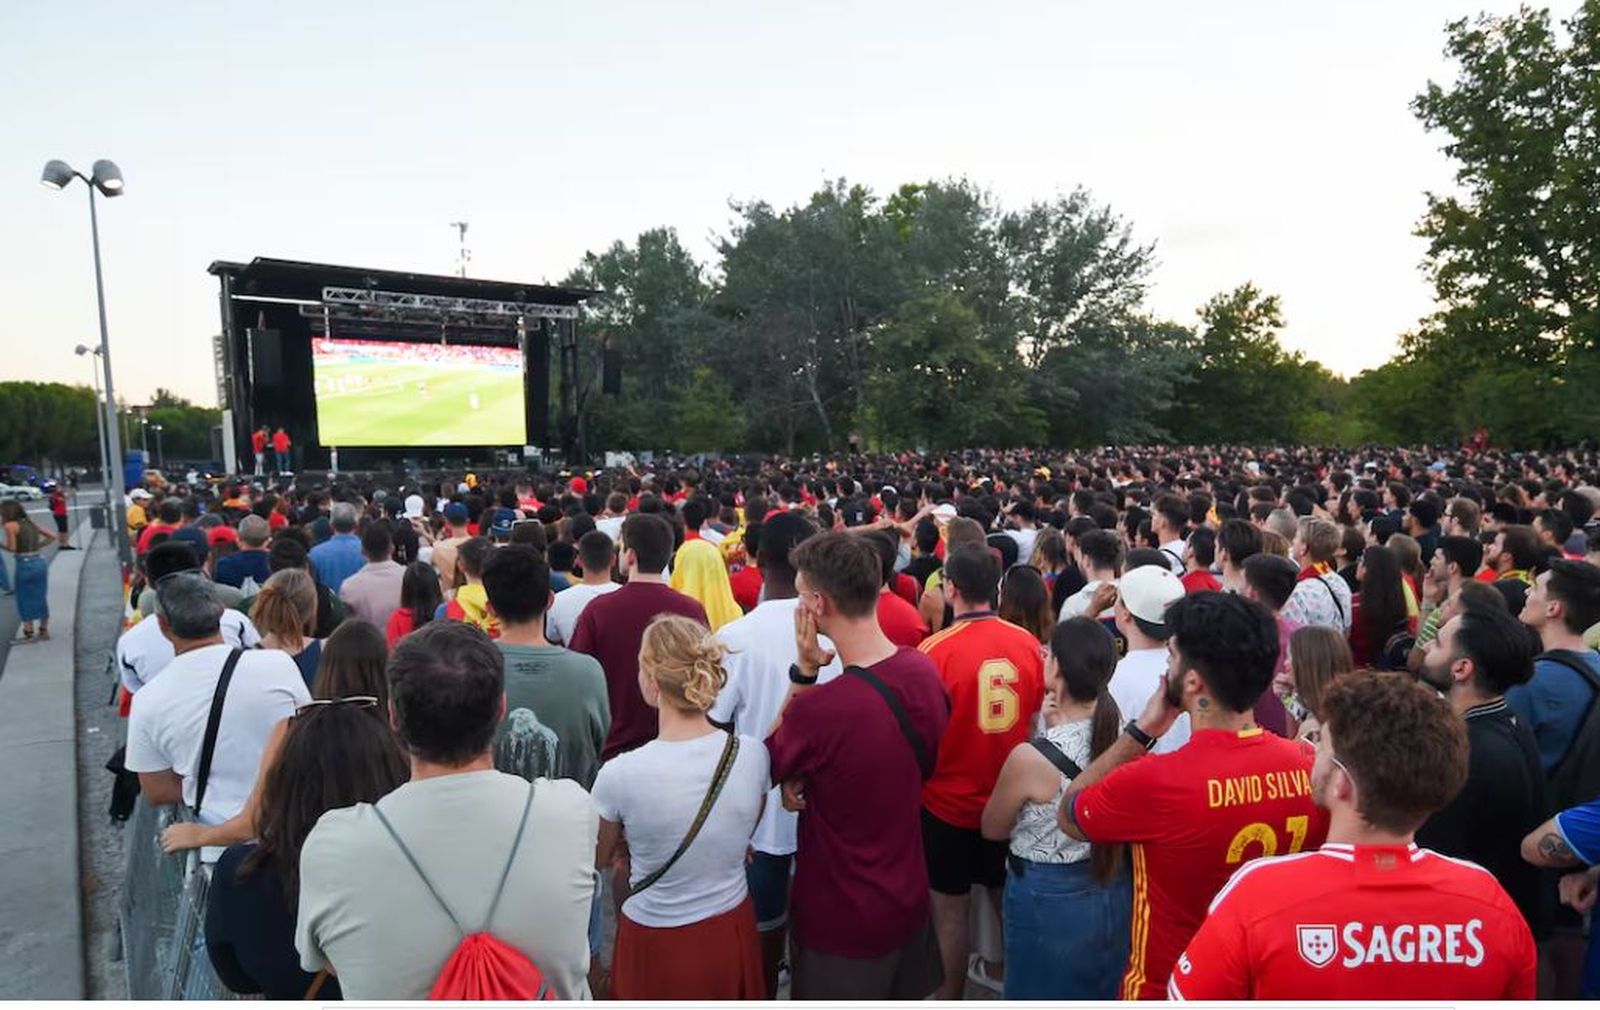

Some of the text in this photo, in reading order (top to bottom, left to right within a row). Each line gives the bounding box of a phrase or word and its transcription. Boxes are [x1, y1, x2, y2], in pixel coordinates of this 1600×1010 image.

[978, 657, 1020, 734] 6
[1207, 769, 1312, 808] DAVID SILVA
[1342, 918, 1485, 968] SAGRES
